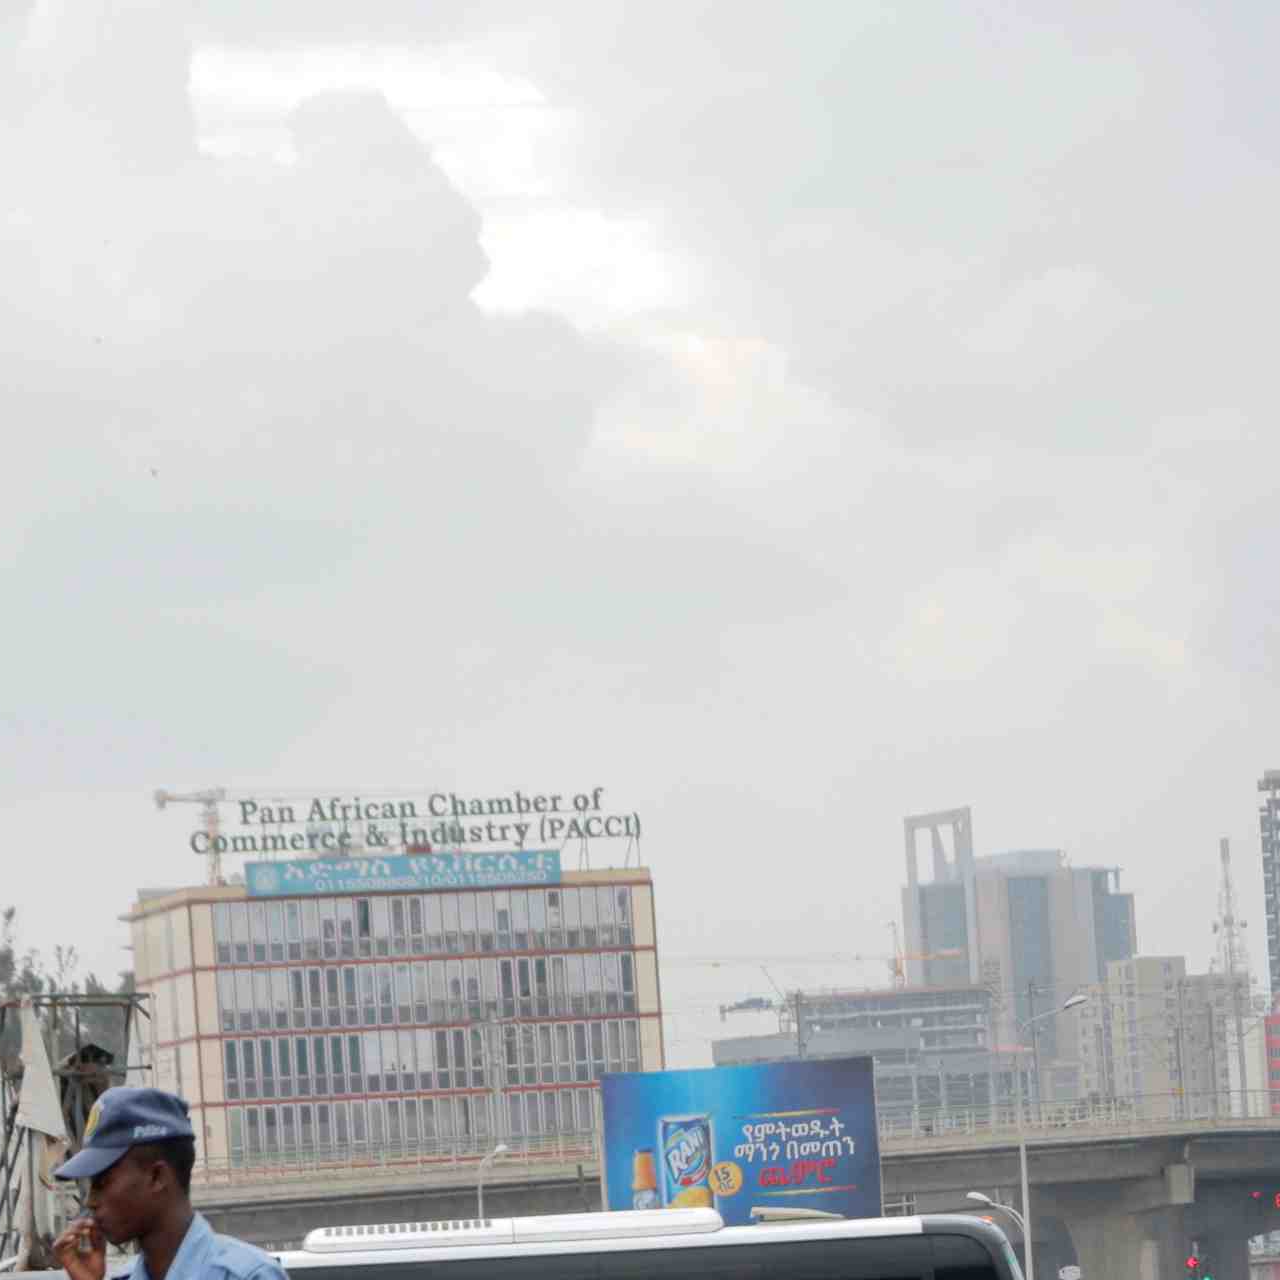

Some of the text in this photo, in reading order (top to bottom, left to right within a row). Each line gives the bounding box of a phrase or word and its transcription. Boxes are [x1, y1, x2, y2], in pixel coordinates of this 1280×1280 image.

[239, 787, 604, 826] Pan African Chamber of
[190, 812, 641, 854] Commerce & Industry (PACCI)
